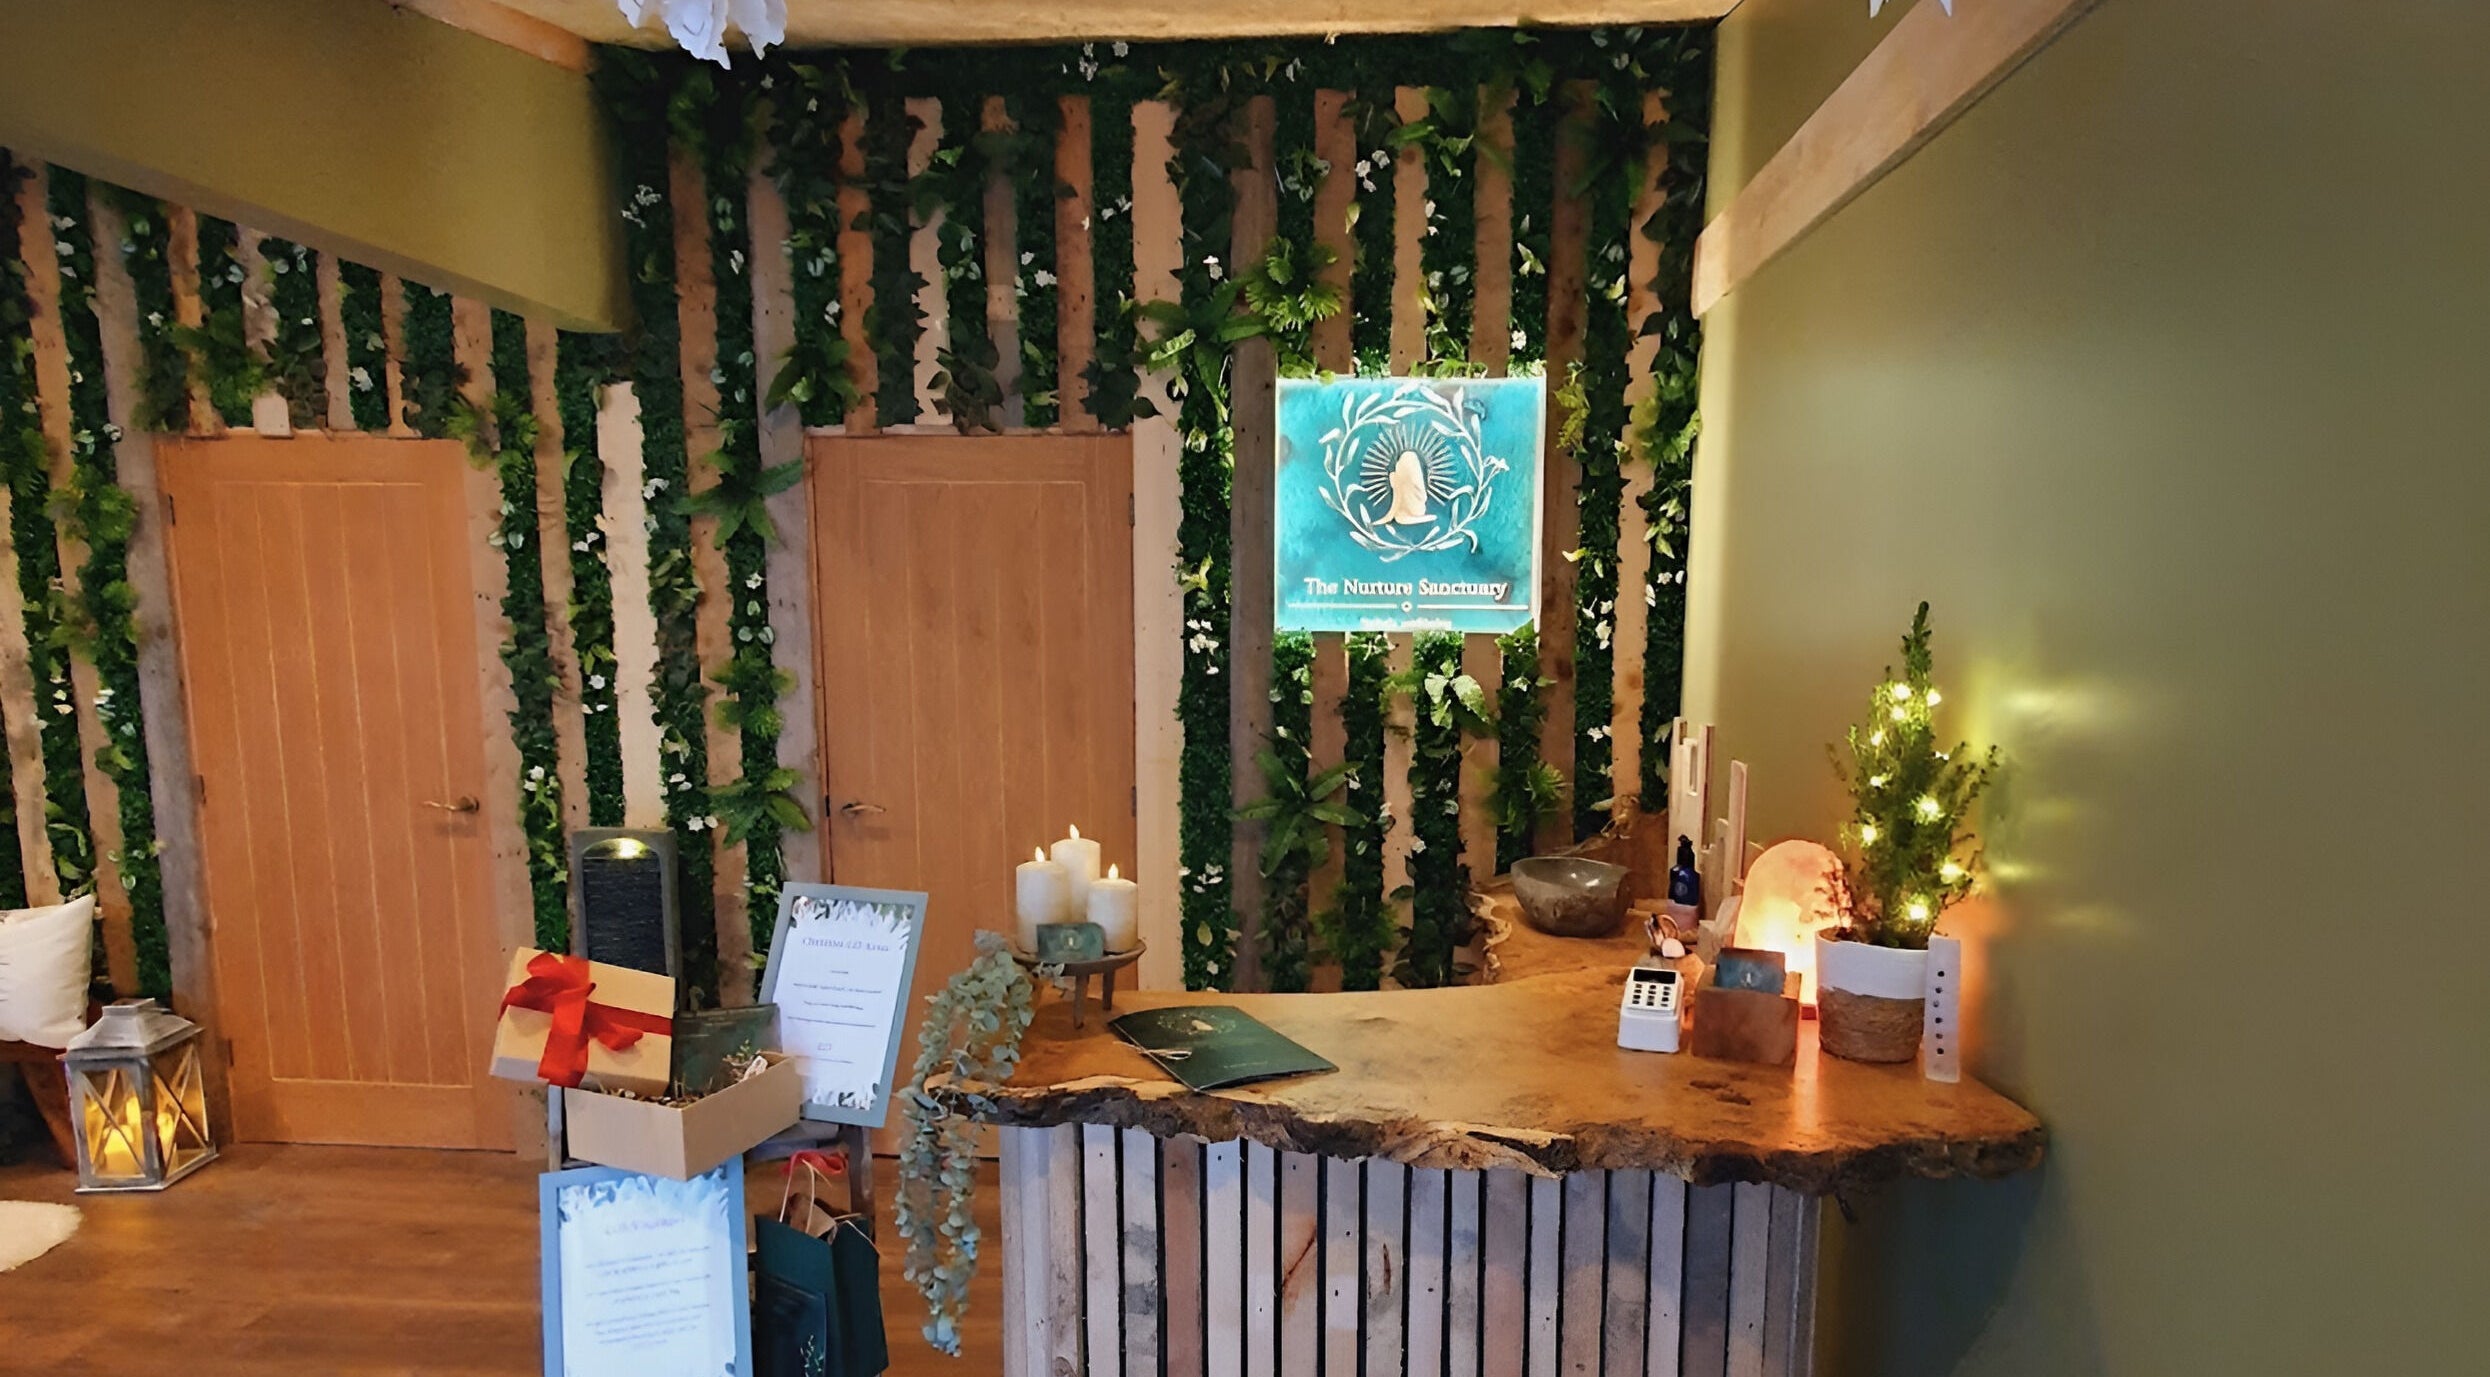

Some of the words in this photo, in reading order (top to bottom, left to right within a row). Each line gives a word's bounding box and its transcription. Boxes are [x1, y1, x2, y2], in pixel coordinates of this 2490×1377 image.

[1304, 577, 1338, 596] The
[1343, 578, 1413, 596] Nurture
[1418, 577, 1508, 601] Sanctuary
